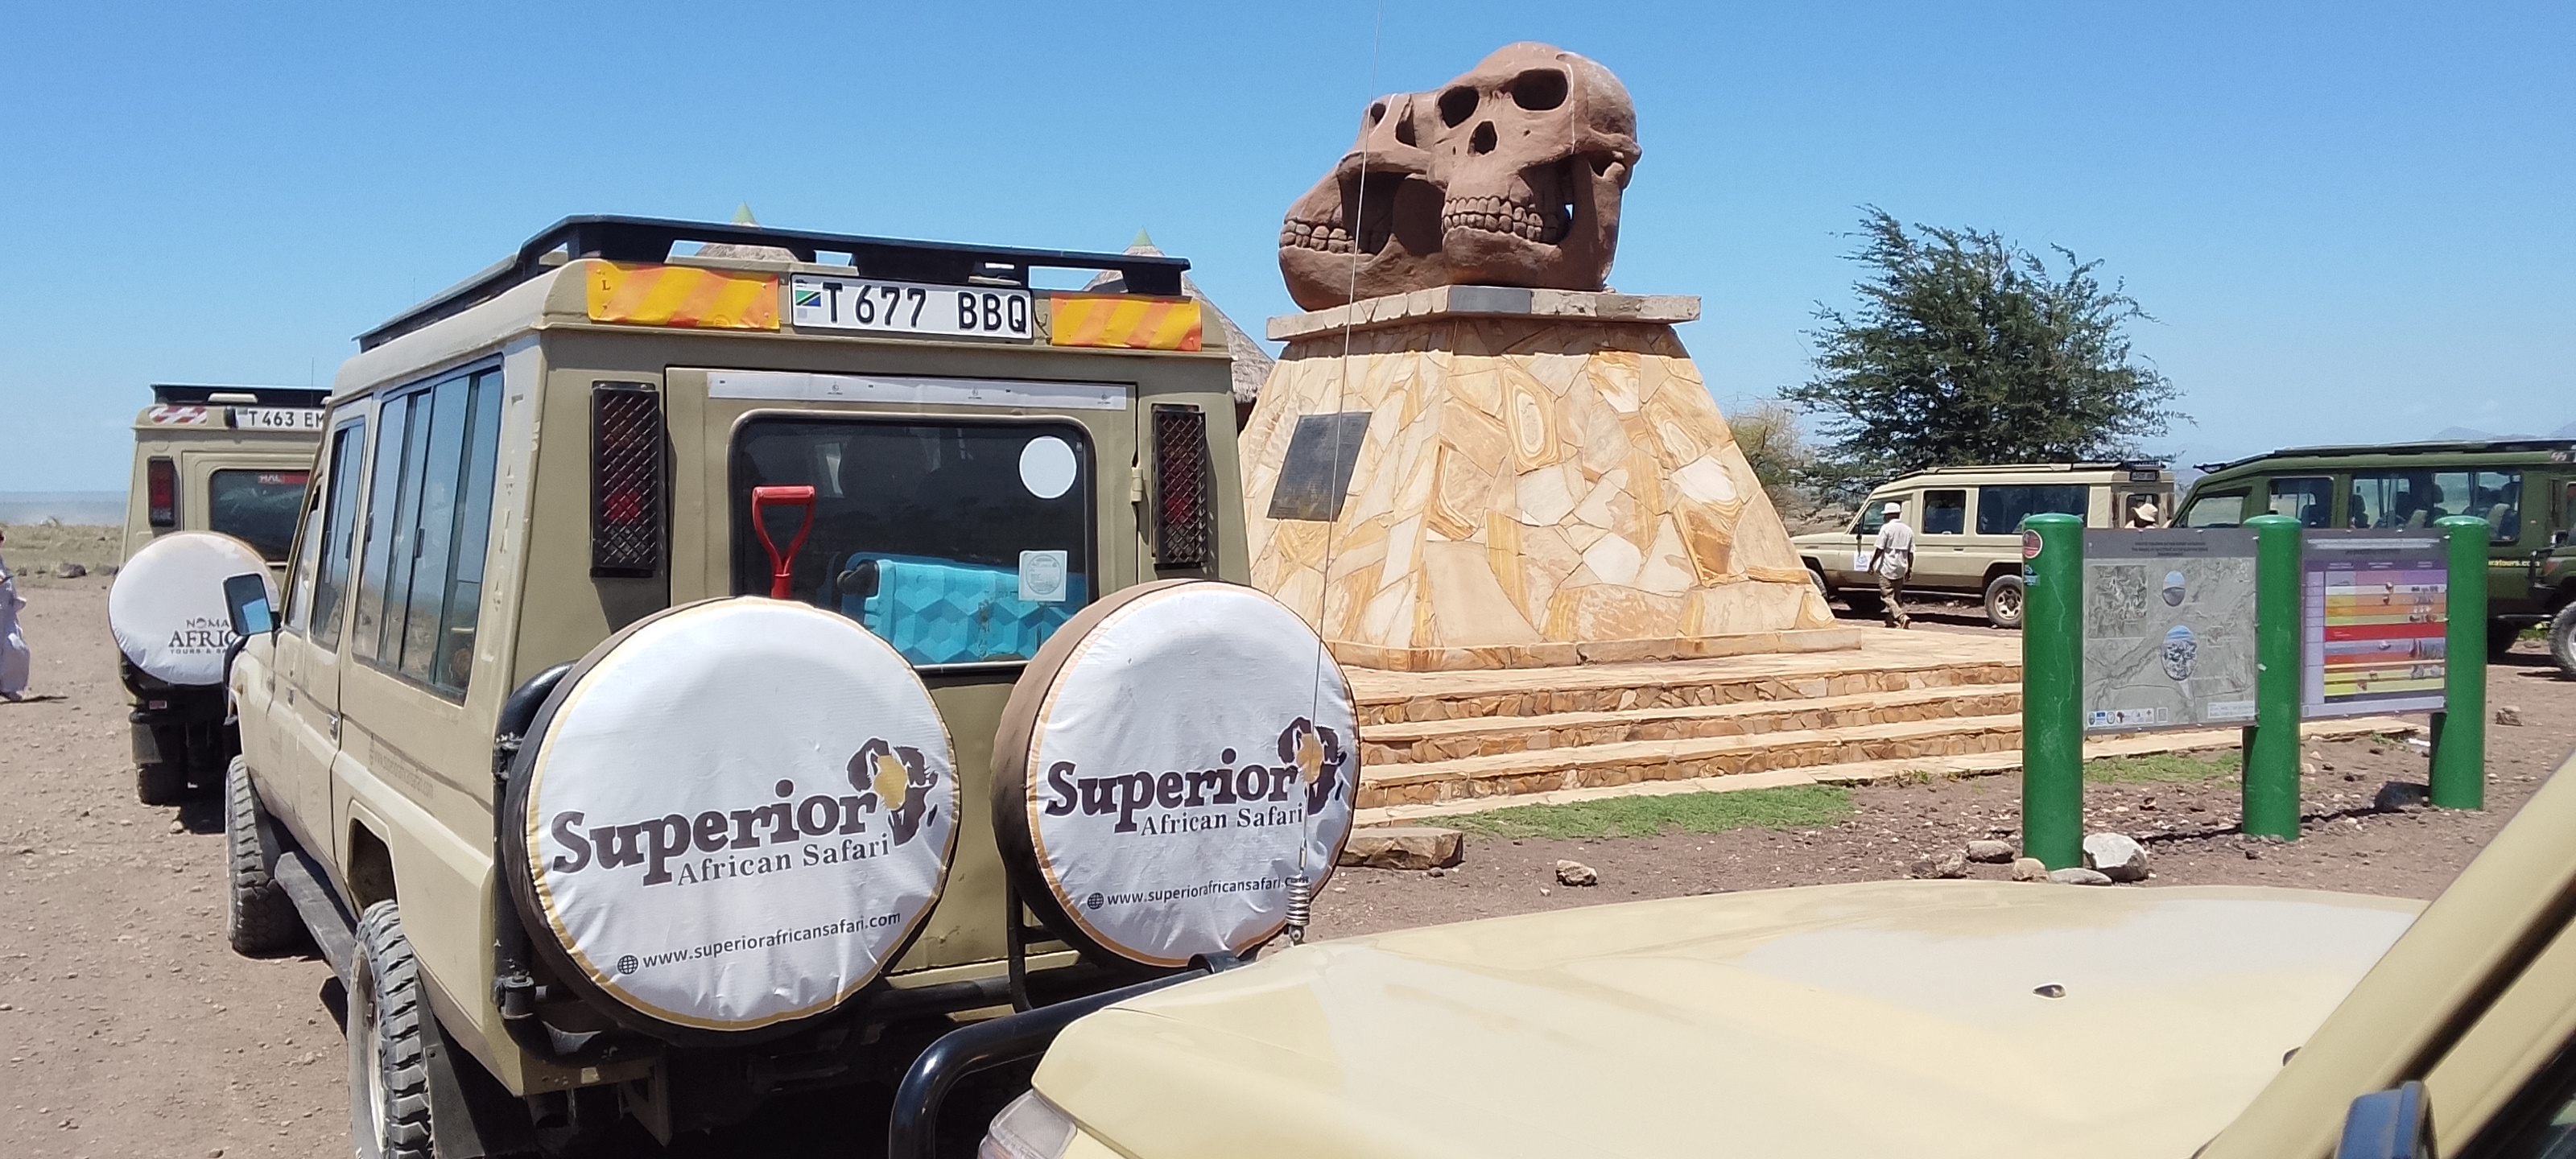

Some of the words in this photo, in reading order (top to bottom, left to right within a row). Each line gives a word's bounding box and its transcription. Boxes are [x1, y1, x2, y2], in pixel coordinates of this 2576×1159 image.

[822, 282, 843, 324] T
[855, 285, 927, 328] 677
[957, 291, 1027, 334] BBQ
[248, 411, 258, 427] T
[262, 410, 295, 427] 463
[1045, 748, 1298, 834] Superior
[551, 779, 877, 887] Superior
[1141, 812, 1228, 835] African
[1236, 802, 1303, 828] Safari
[677, 852, 792, 886] African
[803, 832, 890, 868] Safari
[643, 910, 902, 968] www.superiorafricansafari.com
